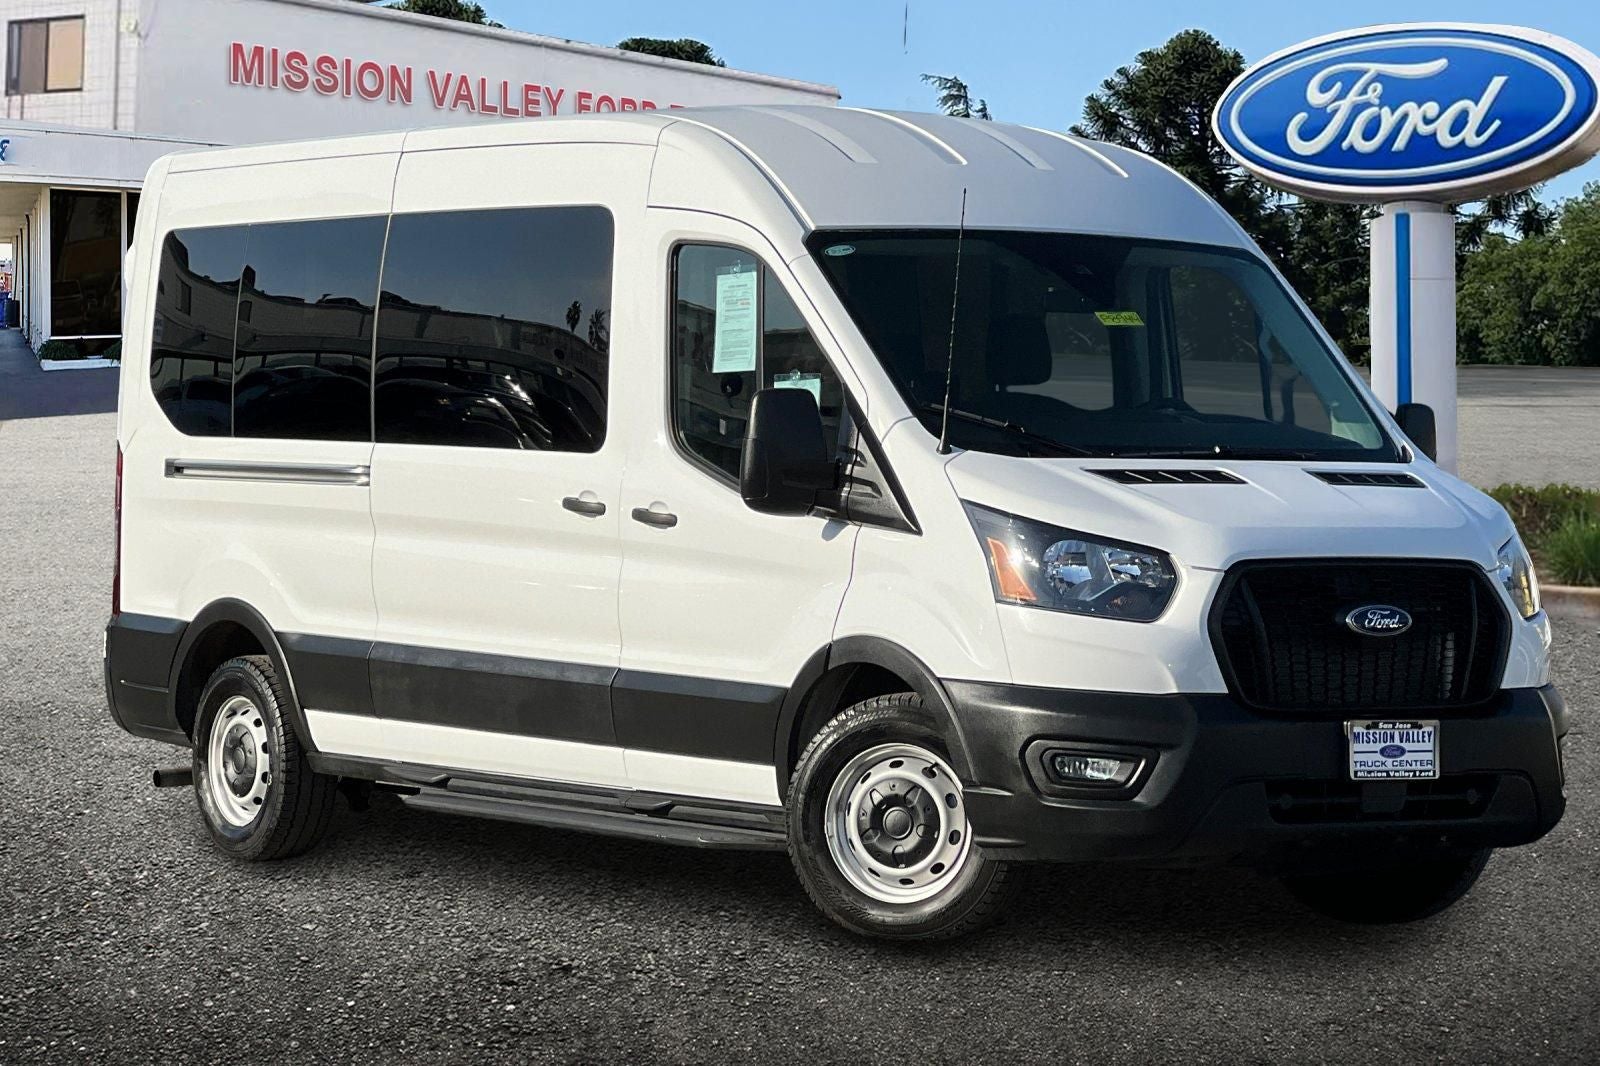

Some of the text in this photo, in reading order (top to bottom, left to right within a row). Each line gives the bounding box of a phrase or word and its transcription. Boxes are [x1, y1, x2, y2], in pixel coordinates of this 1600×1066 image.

[230, 41, 412, 105] MISSION
[427, 69, 564, 117] VALLEY
[1286, 58, 1508, 156] Ford
[1364, 609, 1400, 628] Ford
[1353, 730, 1433, 744] MISSION VALLEY
[1354, 759, 1433, 768] TRUCK CENTER
